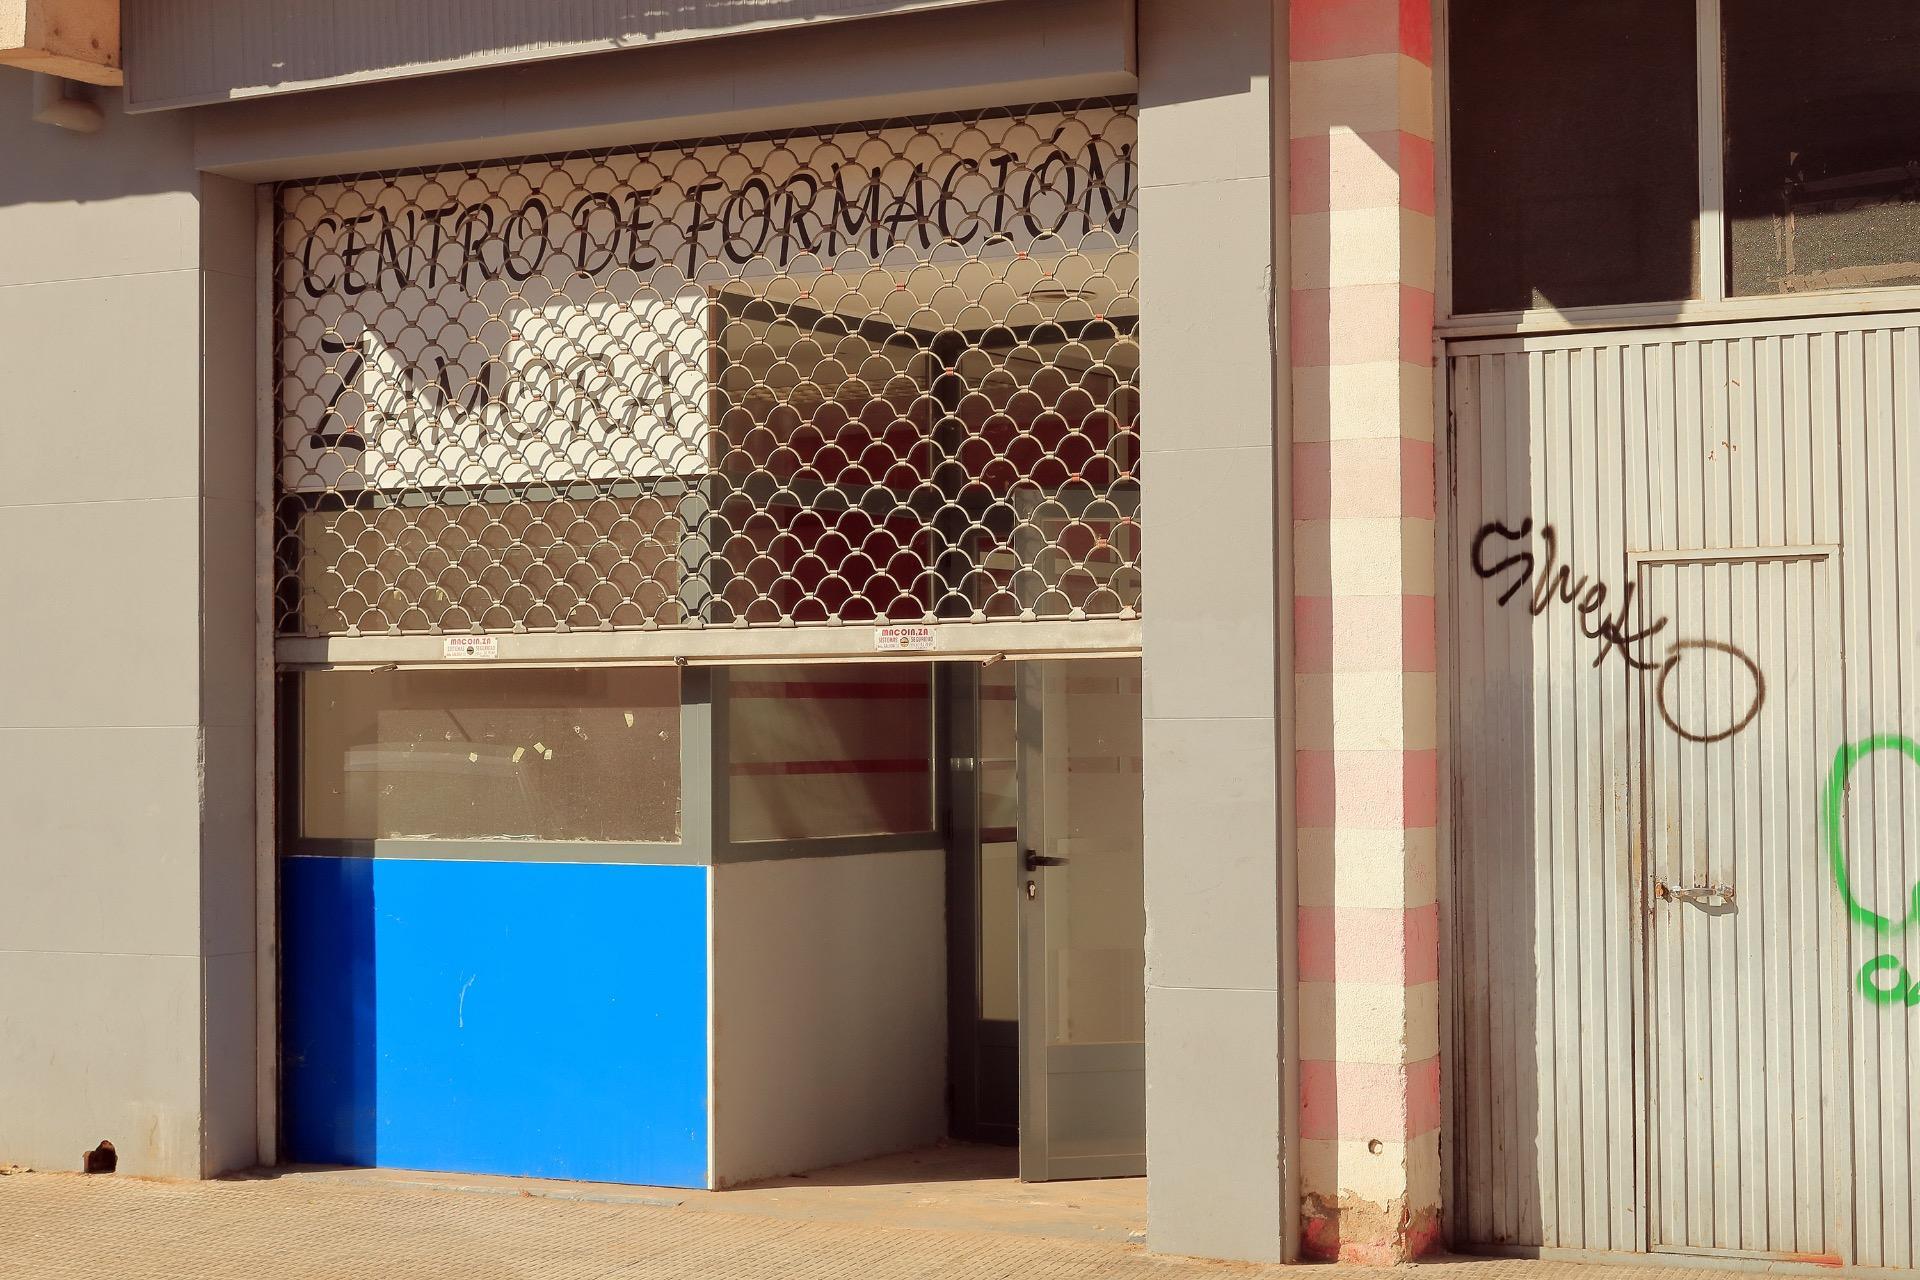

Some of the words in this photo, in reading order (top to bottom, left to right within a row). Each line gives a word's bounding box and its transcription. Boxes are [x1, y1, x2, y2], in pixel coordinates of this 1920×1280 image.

[302, 197, 549, 299] CENTRO
[571, 185, 663, 280] DE
[685, 127, 1132, 280] FORMACIÓN
[309, 336, 675, 451] ZAMORA
